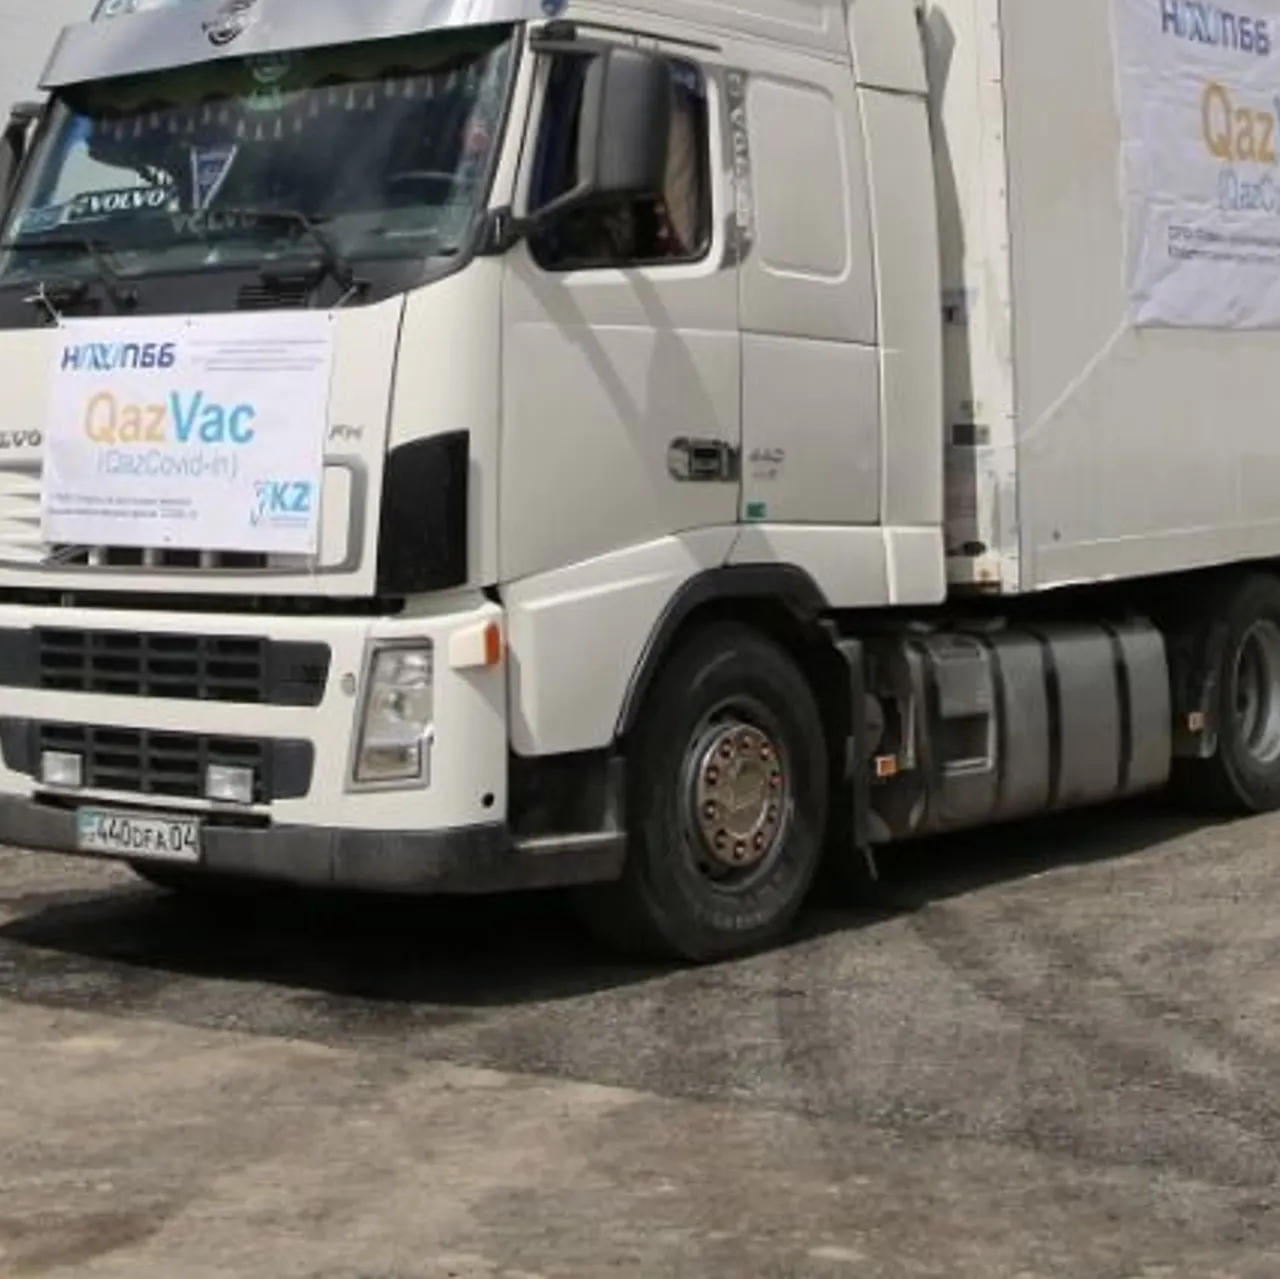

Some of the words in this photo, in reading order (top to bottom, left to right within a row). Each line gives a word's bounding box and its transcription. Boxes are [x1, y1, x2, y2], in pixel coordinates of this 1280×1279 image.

[89, 190, 166, 211] VOLVO
[84, 391, 255, 444] QazVac
[96, 447, 237, 478] (QazCovid-in)
[270, 480, 311, 512] KZ
